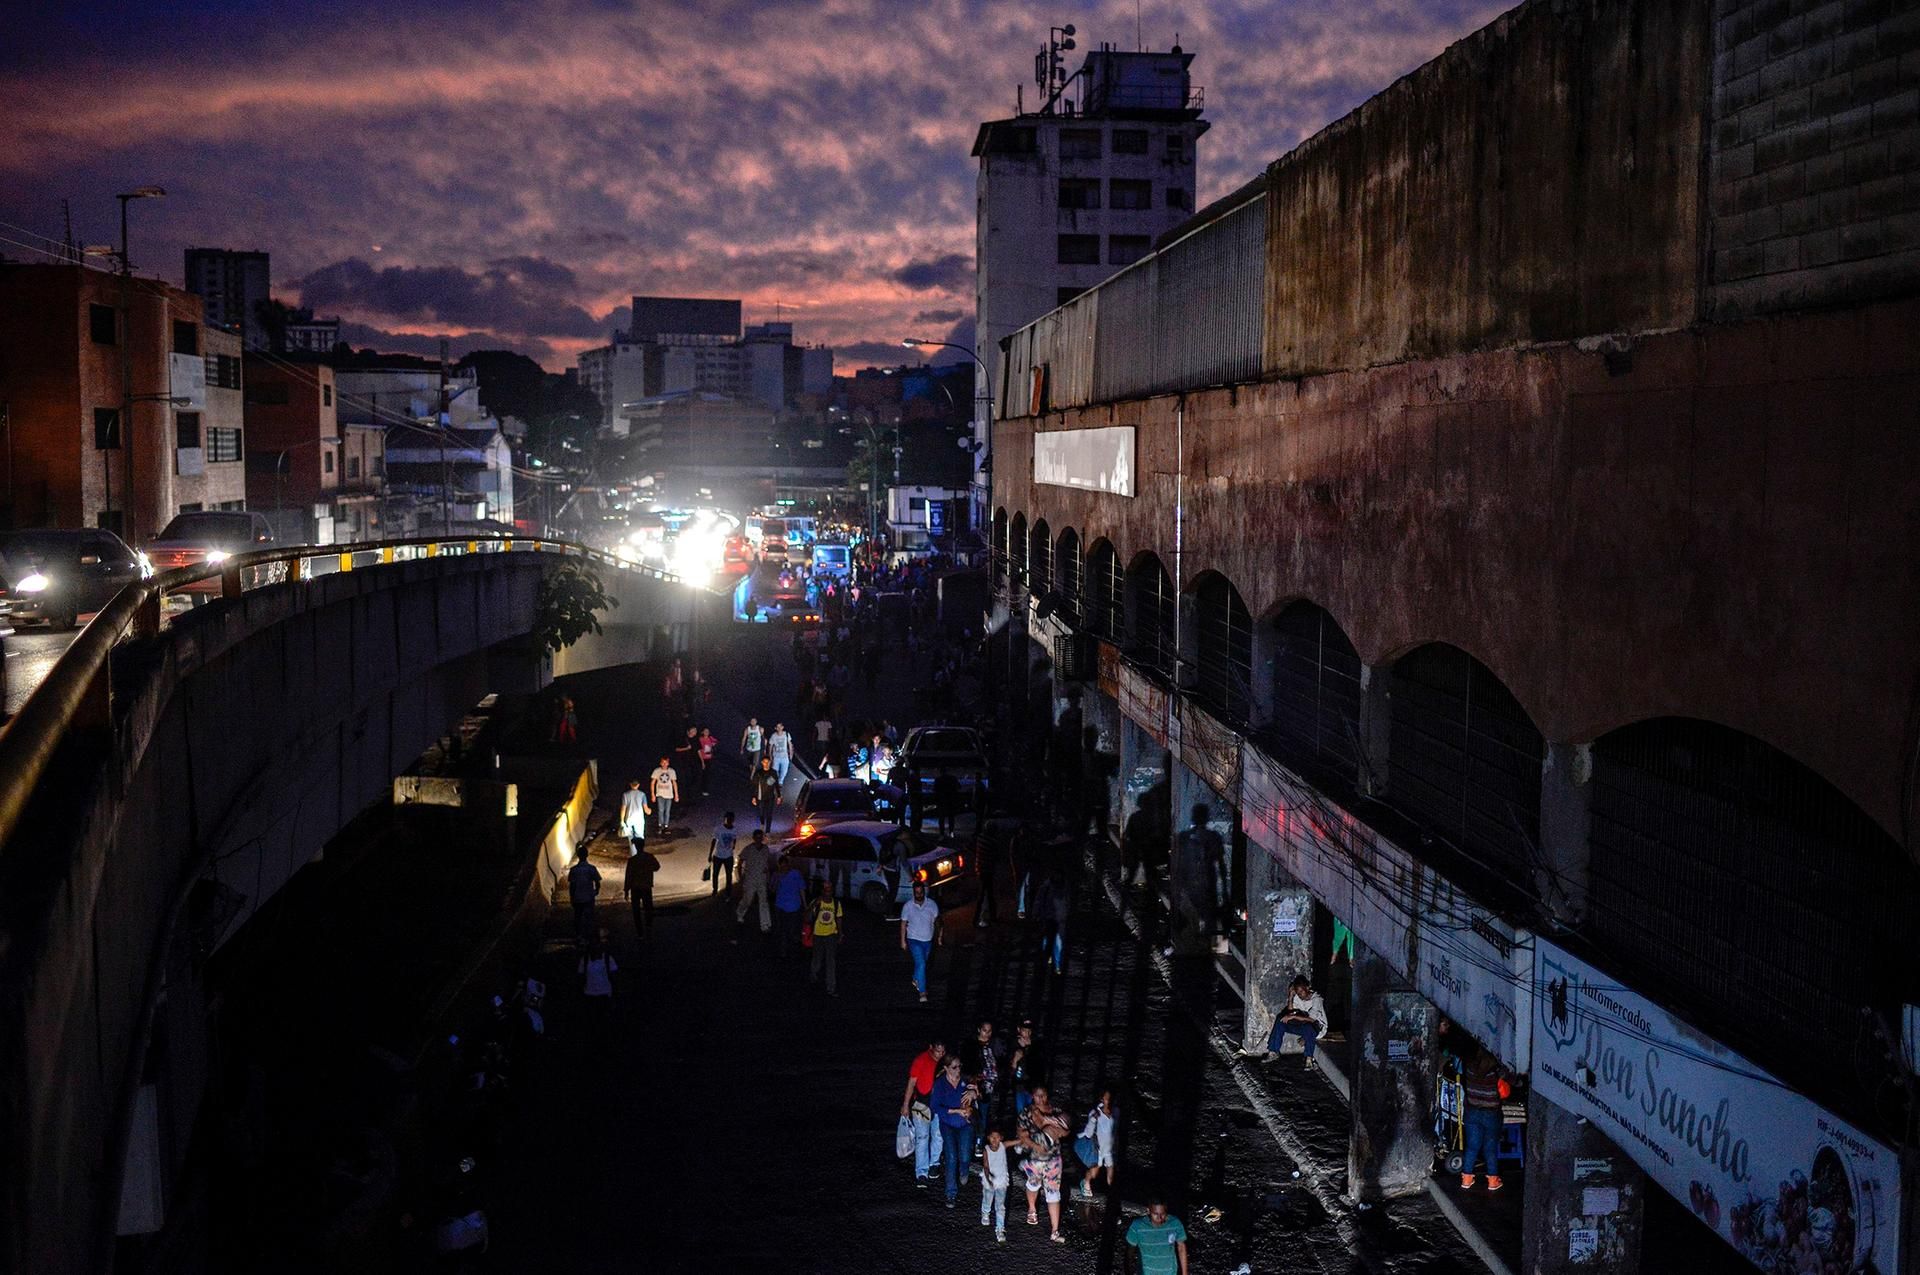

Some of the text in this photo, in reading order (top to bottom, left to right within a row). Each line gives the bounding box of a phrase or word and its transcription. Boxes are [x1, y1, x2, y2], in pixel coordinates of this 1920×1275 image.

[1428, 962, 1462, 1000] KOLESTON
[1580, 978, 1652, 1036] Automercados
[1541, 1061, 1552, 1076] LOS
[1553, 1069, 1578, 1093] MEJORES
[1579, 1086, 1611, 1117] PRODUCTOS
[1612, 1113, 1620, 1123] AL
[1632, 1125, 1648, 1145] BAJO
[1578, 1008, 1752, 1183] Don Sancho
